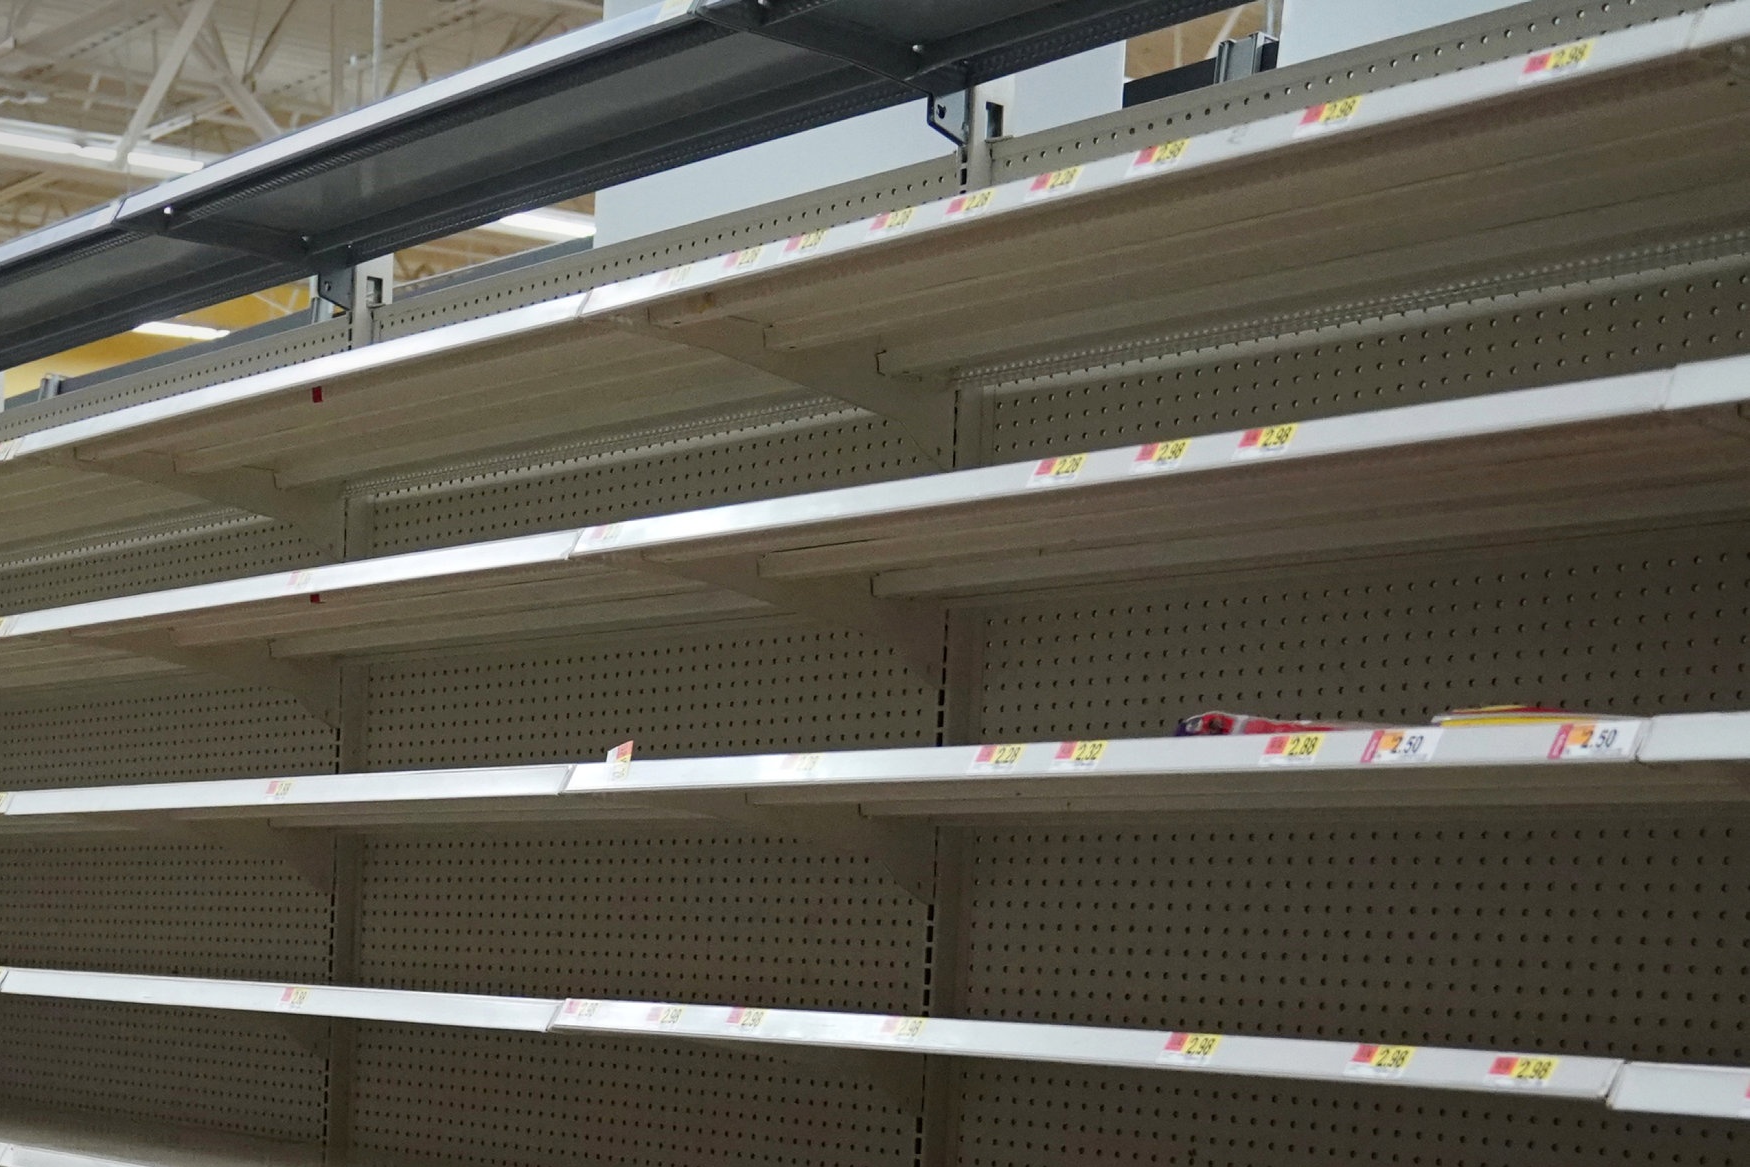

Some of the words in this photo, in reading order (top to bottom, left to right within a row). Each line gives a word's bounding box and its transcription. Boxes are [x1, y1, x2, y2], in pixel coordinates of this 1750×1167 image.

[1260, 425, 1292, 447] 2.98
[1156, 440, 1183, 462] 2.98
[1287, 736, 1319, 756] 2.88
[1390, 735, 1425, 755] 2.50
[1580, 729, 1618, 749] 2.50
[1186, 1036, 1216, 1056] 2.98
[1376, 1048, 1409, 1068] 2.98
[1516, 1059, 1552, 1080] 2.98
